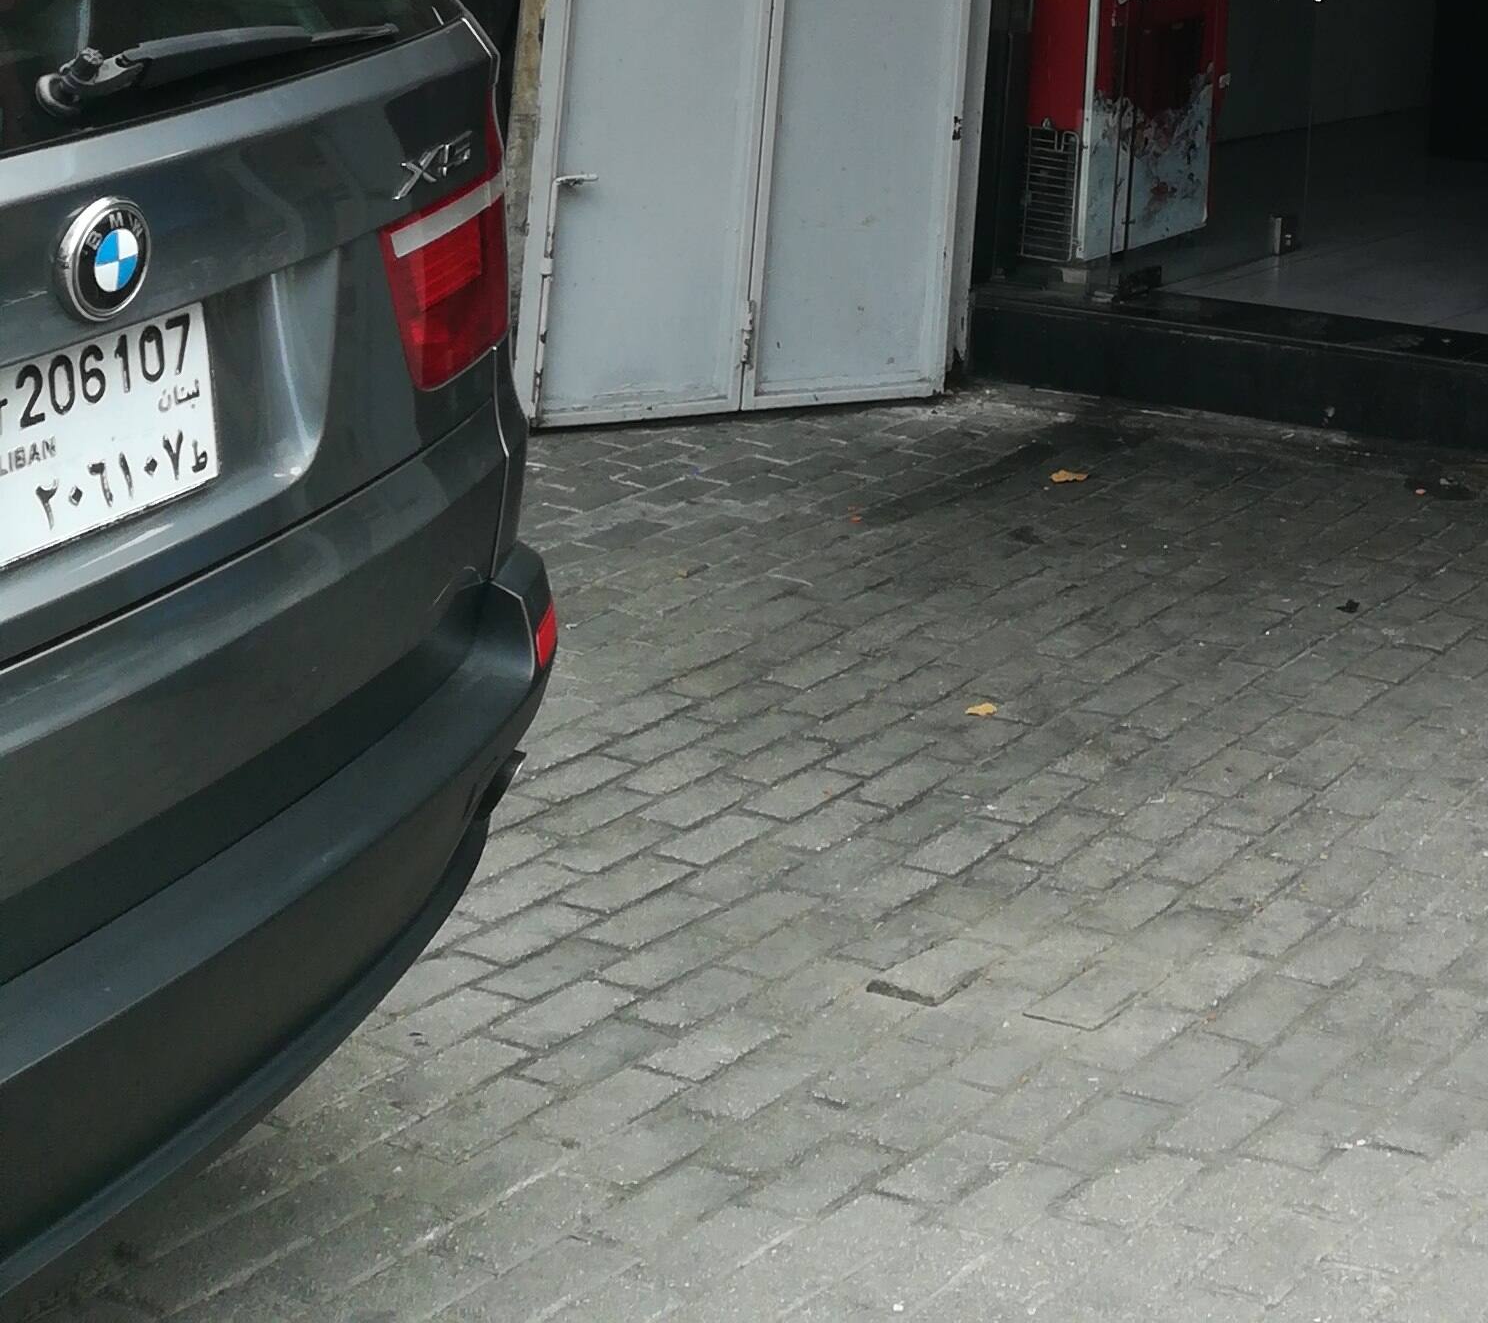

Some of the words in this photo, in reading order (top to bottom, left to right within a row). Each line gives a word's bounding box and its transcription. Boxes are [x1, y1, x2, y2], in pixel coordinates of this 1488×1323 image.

[392, 130, 473, 202] X5
[83, 211, 144, 251] BMW
[16, 313, 190, 429] 206107
[157, 378, 201, 413] لبنان
